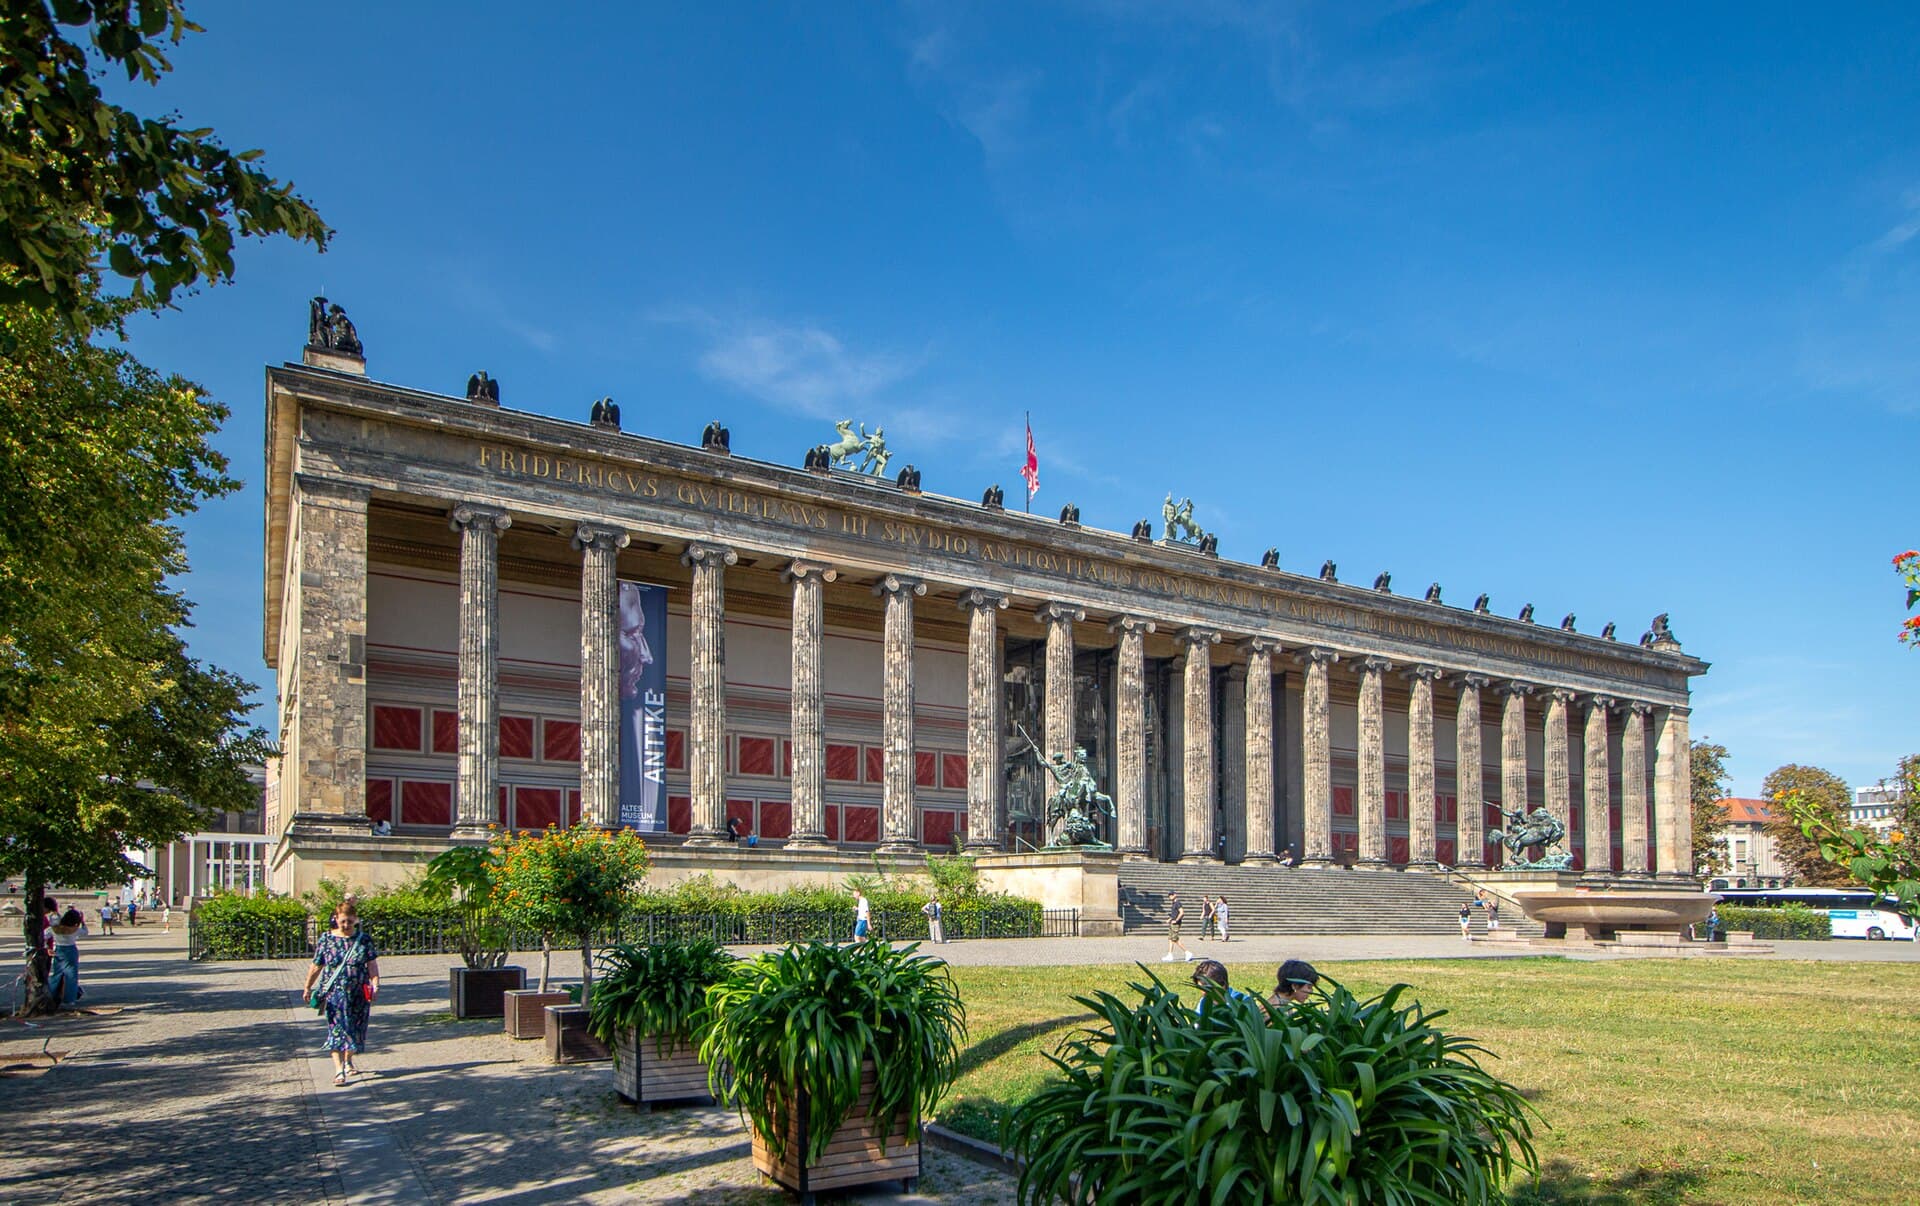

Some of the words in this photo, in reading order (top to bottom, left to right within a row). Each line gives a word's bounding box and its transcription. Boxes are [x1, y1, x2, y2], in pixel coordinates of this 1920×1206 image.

[479, 445, 659, 498] FRIDERICVS
[677, 482, 828, 530] GVILELMVS
[841, 514, 869, 537] III
[882, 521, 968, 556] STVDIO
[981, 543, 1132, 585] ANTIQVITATIS
[621, 804, 643, 812] ALTES
[621, 811, 653, 820] MUSEUM
